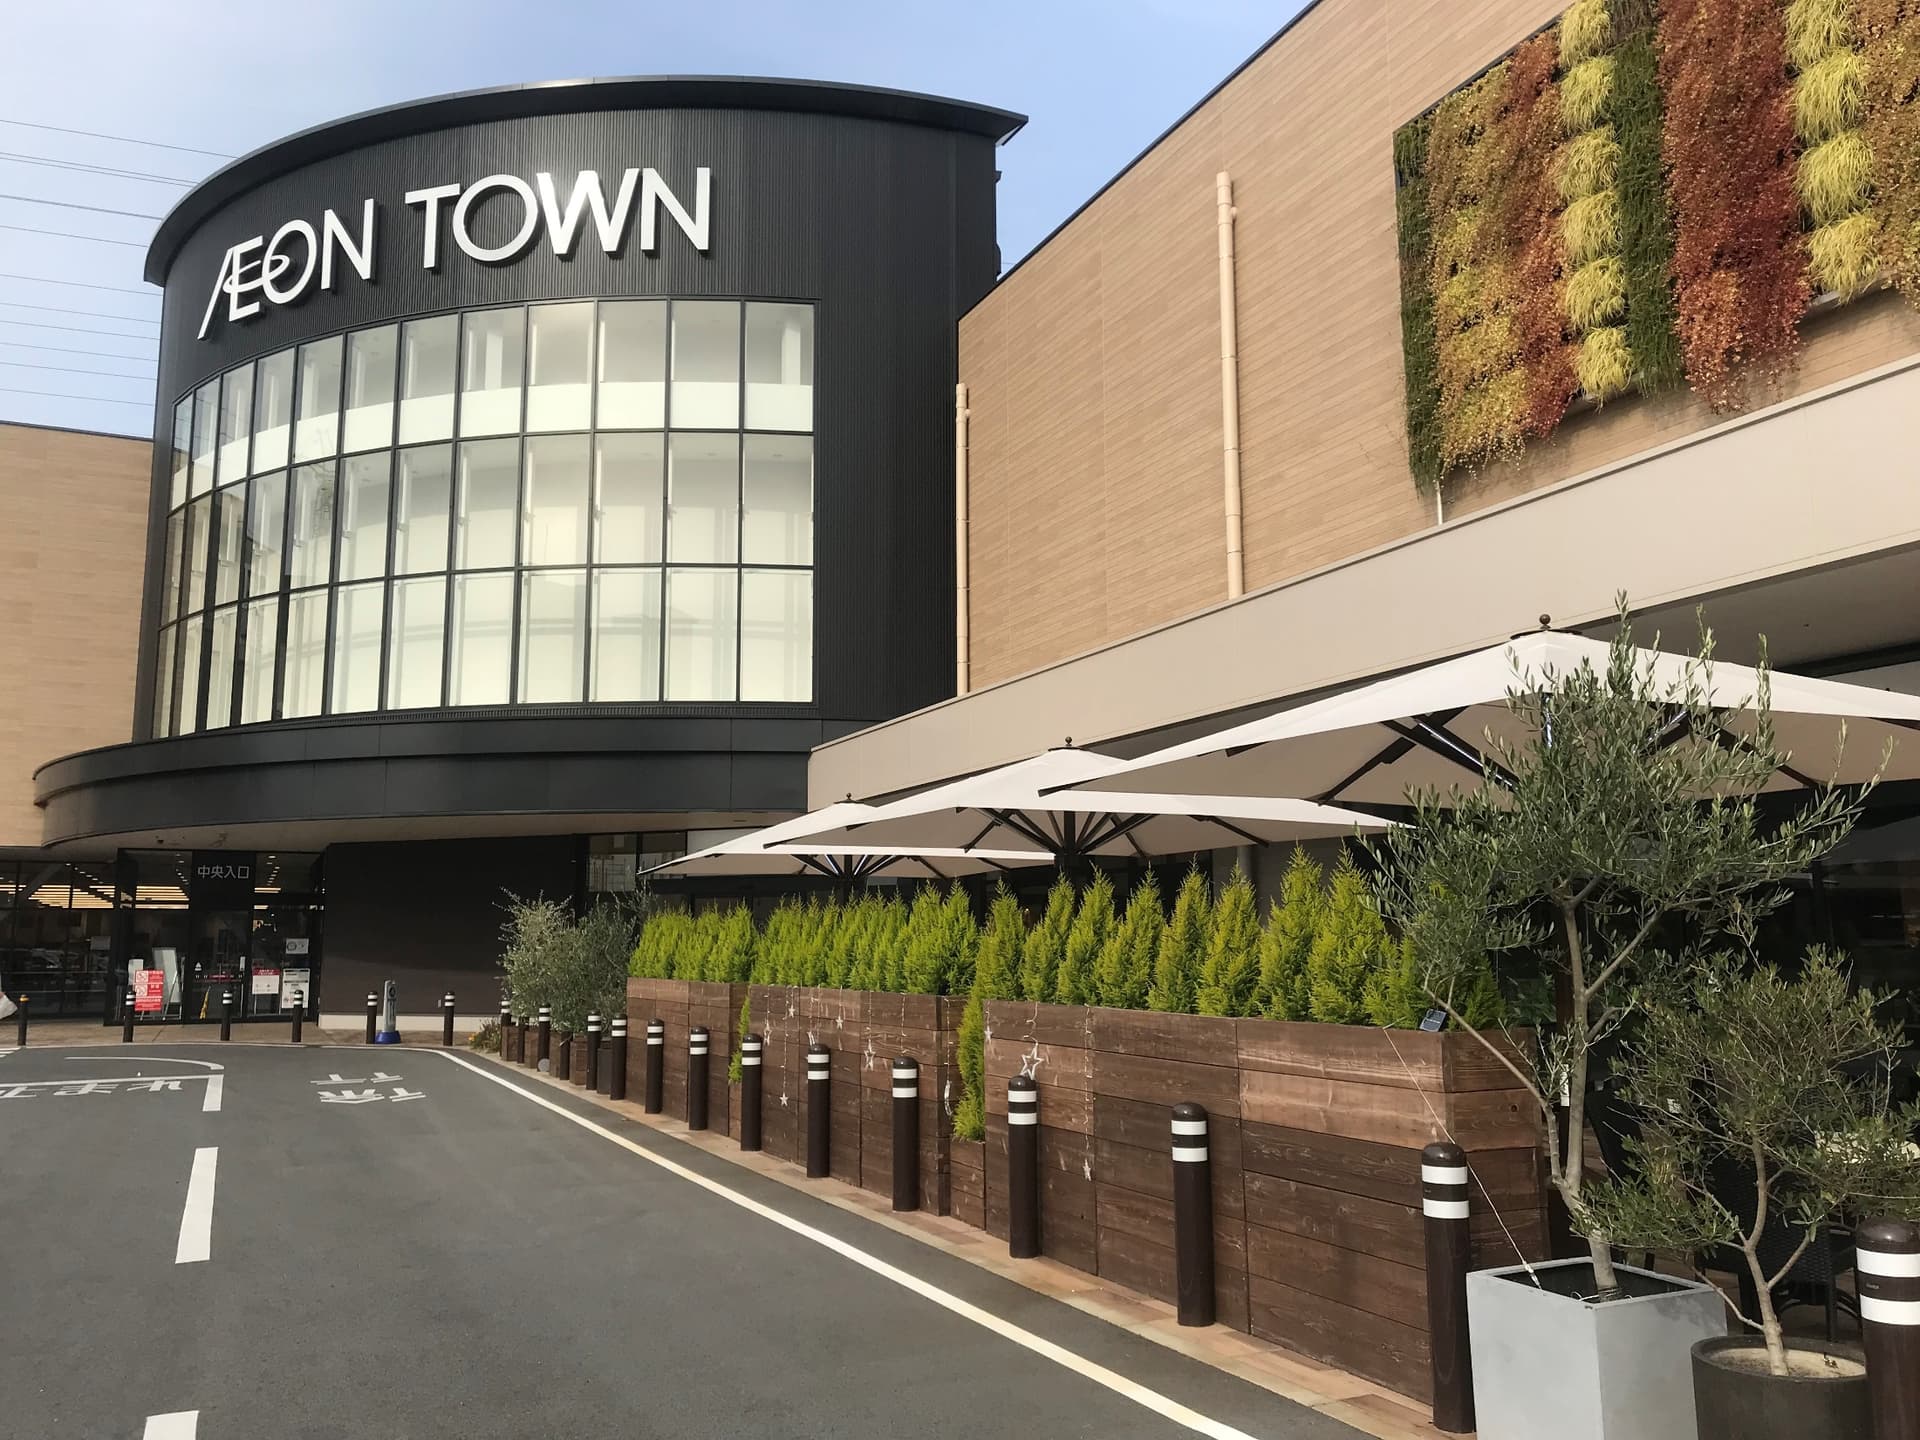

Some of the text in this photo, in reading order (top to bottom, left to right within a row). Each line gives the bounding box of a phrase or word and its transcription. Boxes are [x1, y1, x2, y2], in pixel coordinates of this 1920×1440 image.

[405, 167, 711, 270] TOWN
[198, 865, 249, 879] 中央入口
